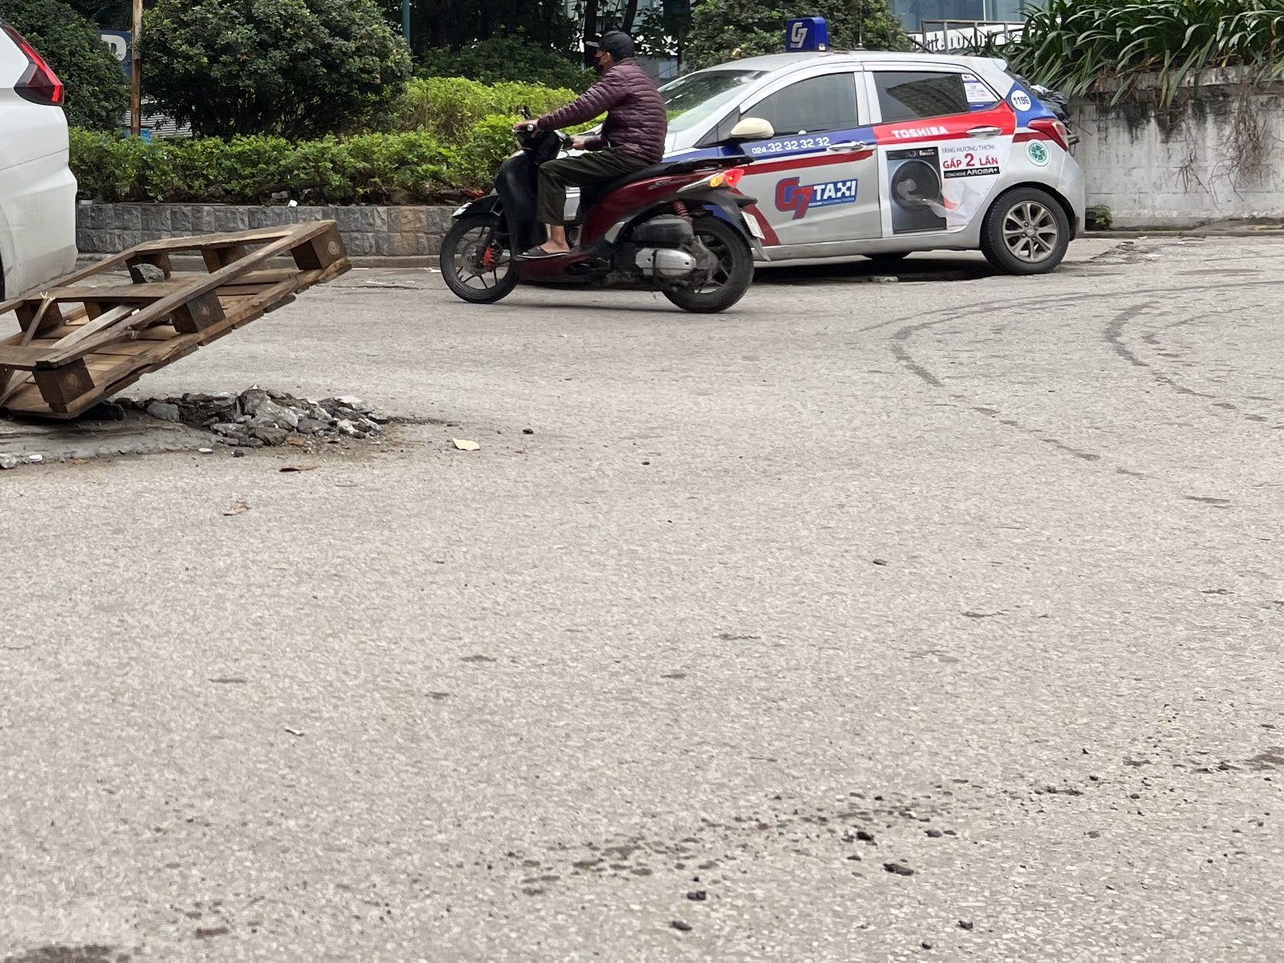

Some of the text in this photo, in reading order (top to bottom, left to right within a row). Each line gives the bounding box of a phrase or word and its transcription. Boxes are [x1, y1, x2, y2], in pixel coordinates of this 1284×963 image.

[791, 22, 808, 48] G7
[101, 34, 126, 61] P
[891, 126, 949, 139] TOSHIBA
[768, 143, 783, 152] 32
[784, 141, 798, 151] 32
[800, 139, 814, 149] 32
[816, 136, 831, 147] 32
[943, 156, 962, 169] GẤP
[964, 153, 975, 167] 2
[775, 176, 857, 220] G7 TAXI
